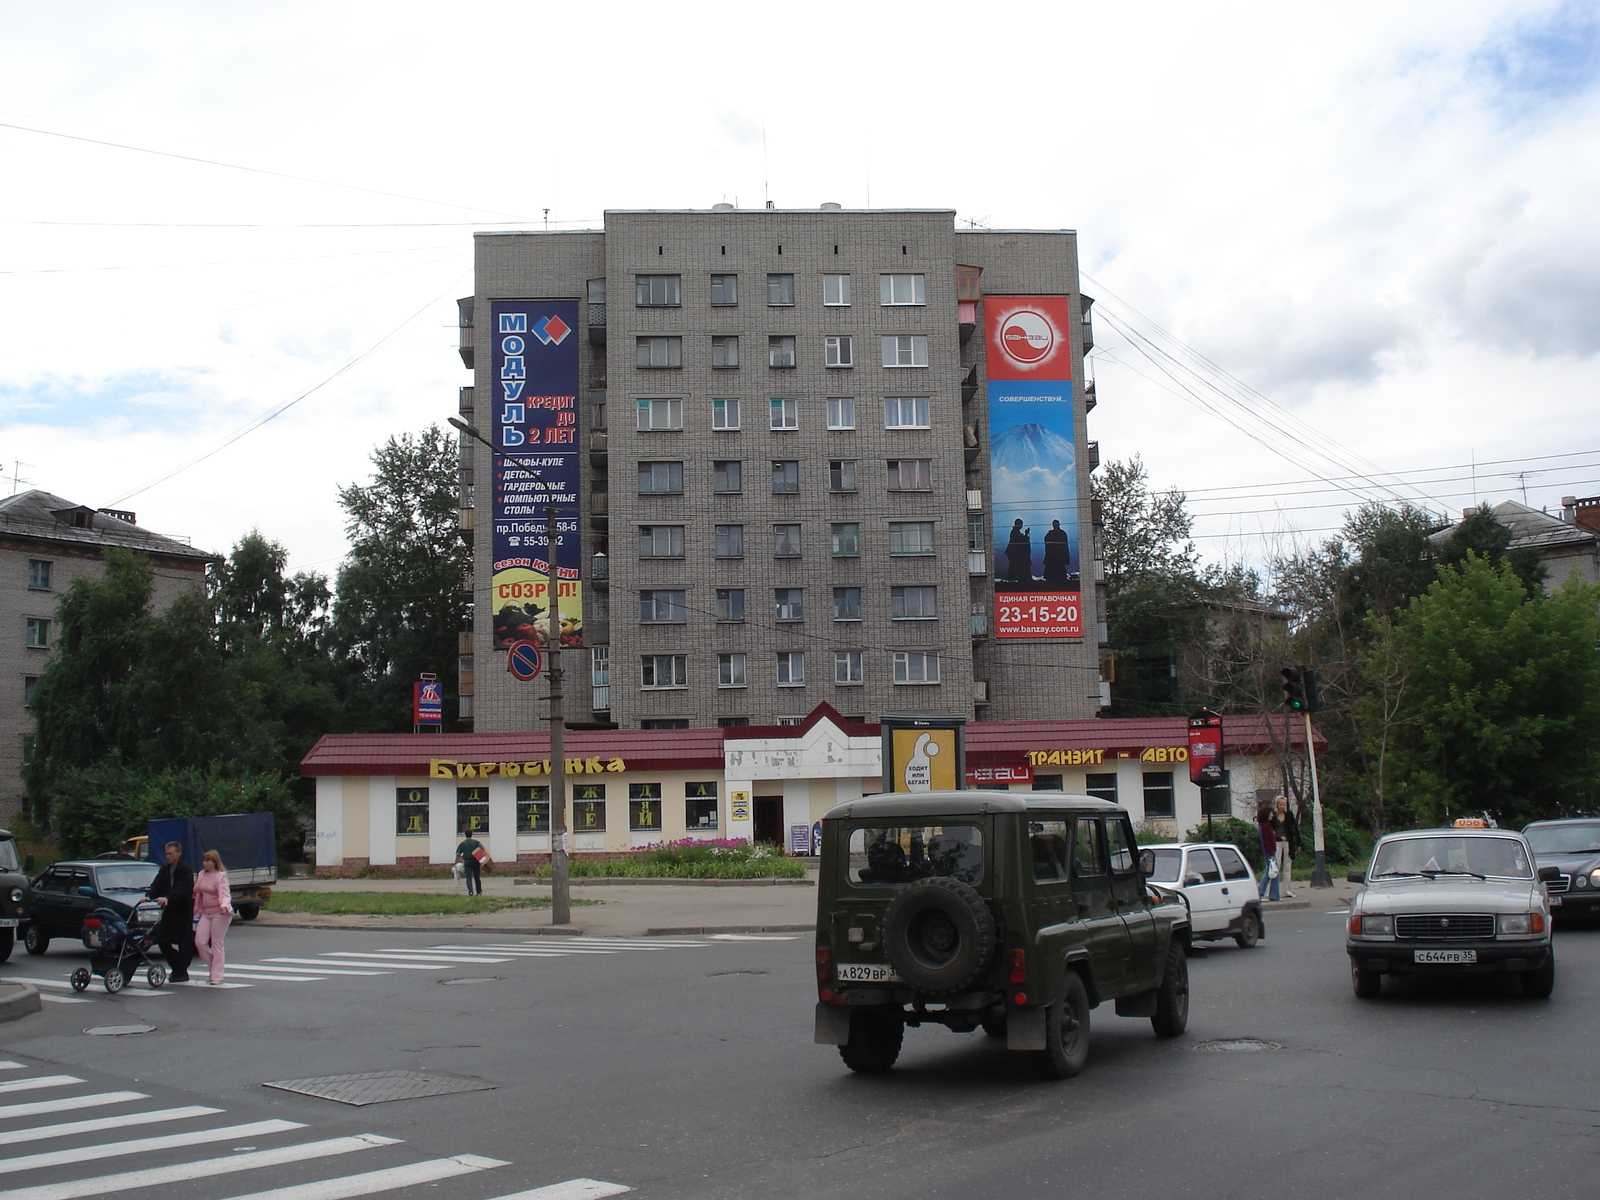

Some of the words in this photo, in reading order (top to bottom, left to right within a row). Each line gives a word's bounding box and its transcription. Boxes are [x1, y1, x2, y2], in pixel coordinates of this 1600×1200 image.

[499, 313, 527, 446] МОДУЛЬ
[527, 396, 575, 410] КРЕДИТ
[556, 411, 575, 426] ДО
[528, 428, 541, 444] 2
[543, 427, 575, 444] ЛЕТ
[503, 493, 576, 503] КОМПЬЮТРНЫЕ
[504, 506, 535, 515] СТОЛЫ
[523, 536, 563, 546] 55-392
[498, 583, 577, 598] СОЗРЛ!
[999, 606, 1077, 622] 23-15-20
[999, 625, 1079, 634] www.banzay.com.ru
[1026, 749, 1106, 767] ТРАНЗИТ
[1141, 747, 1189, 763] АВТО
